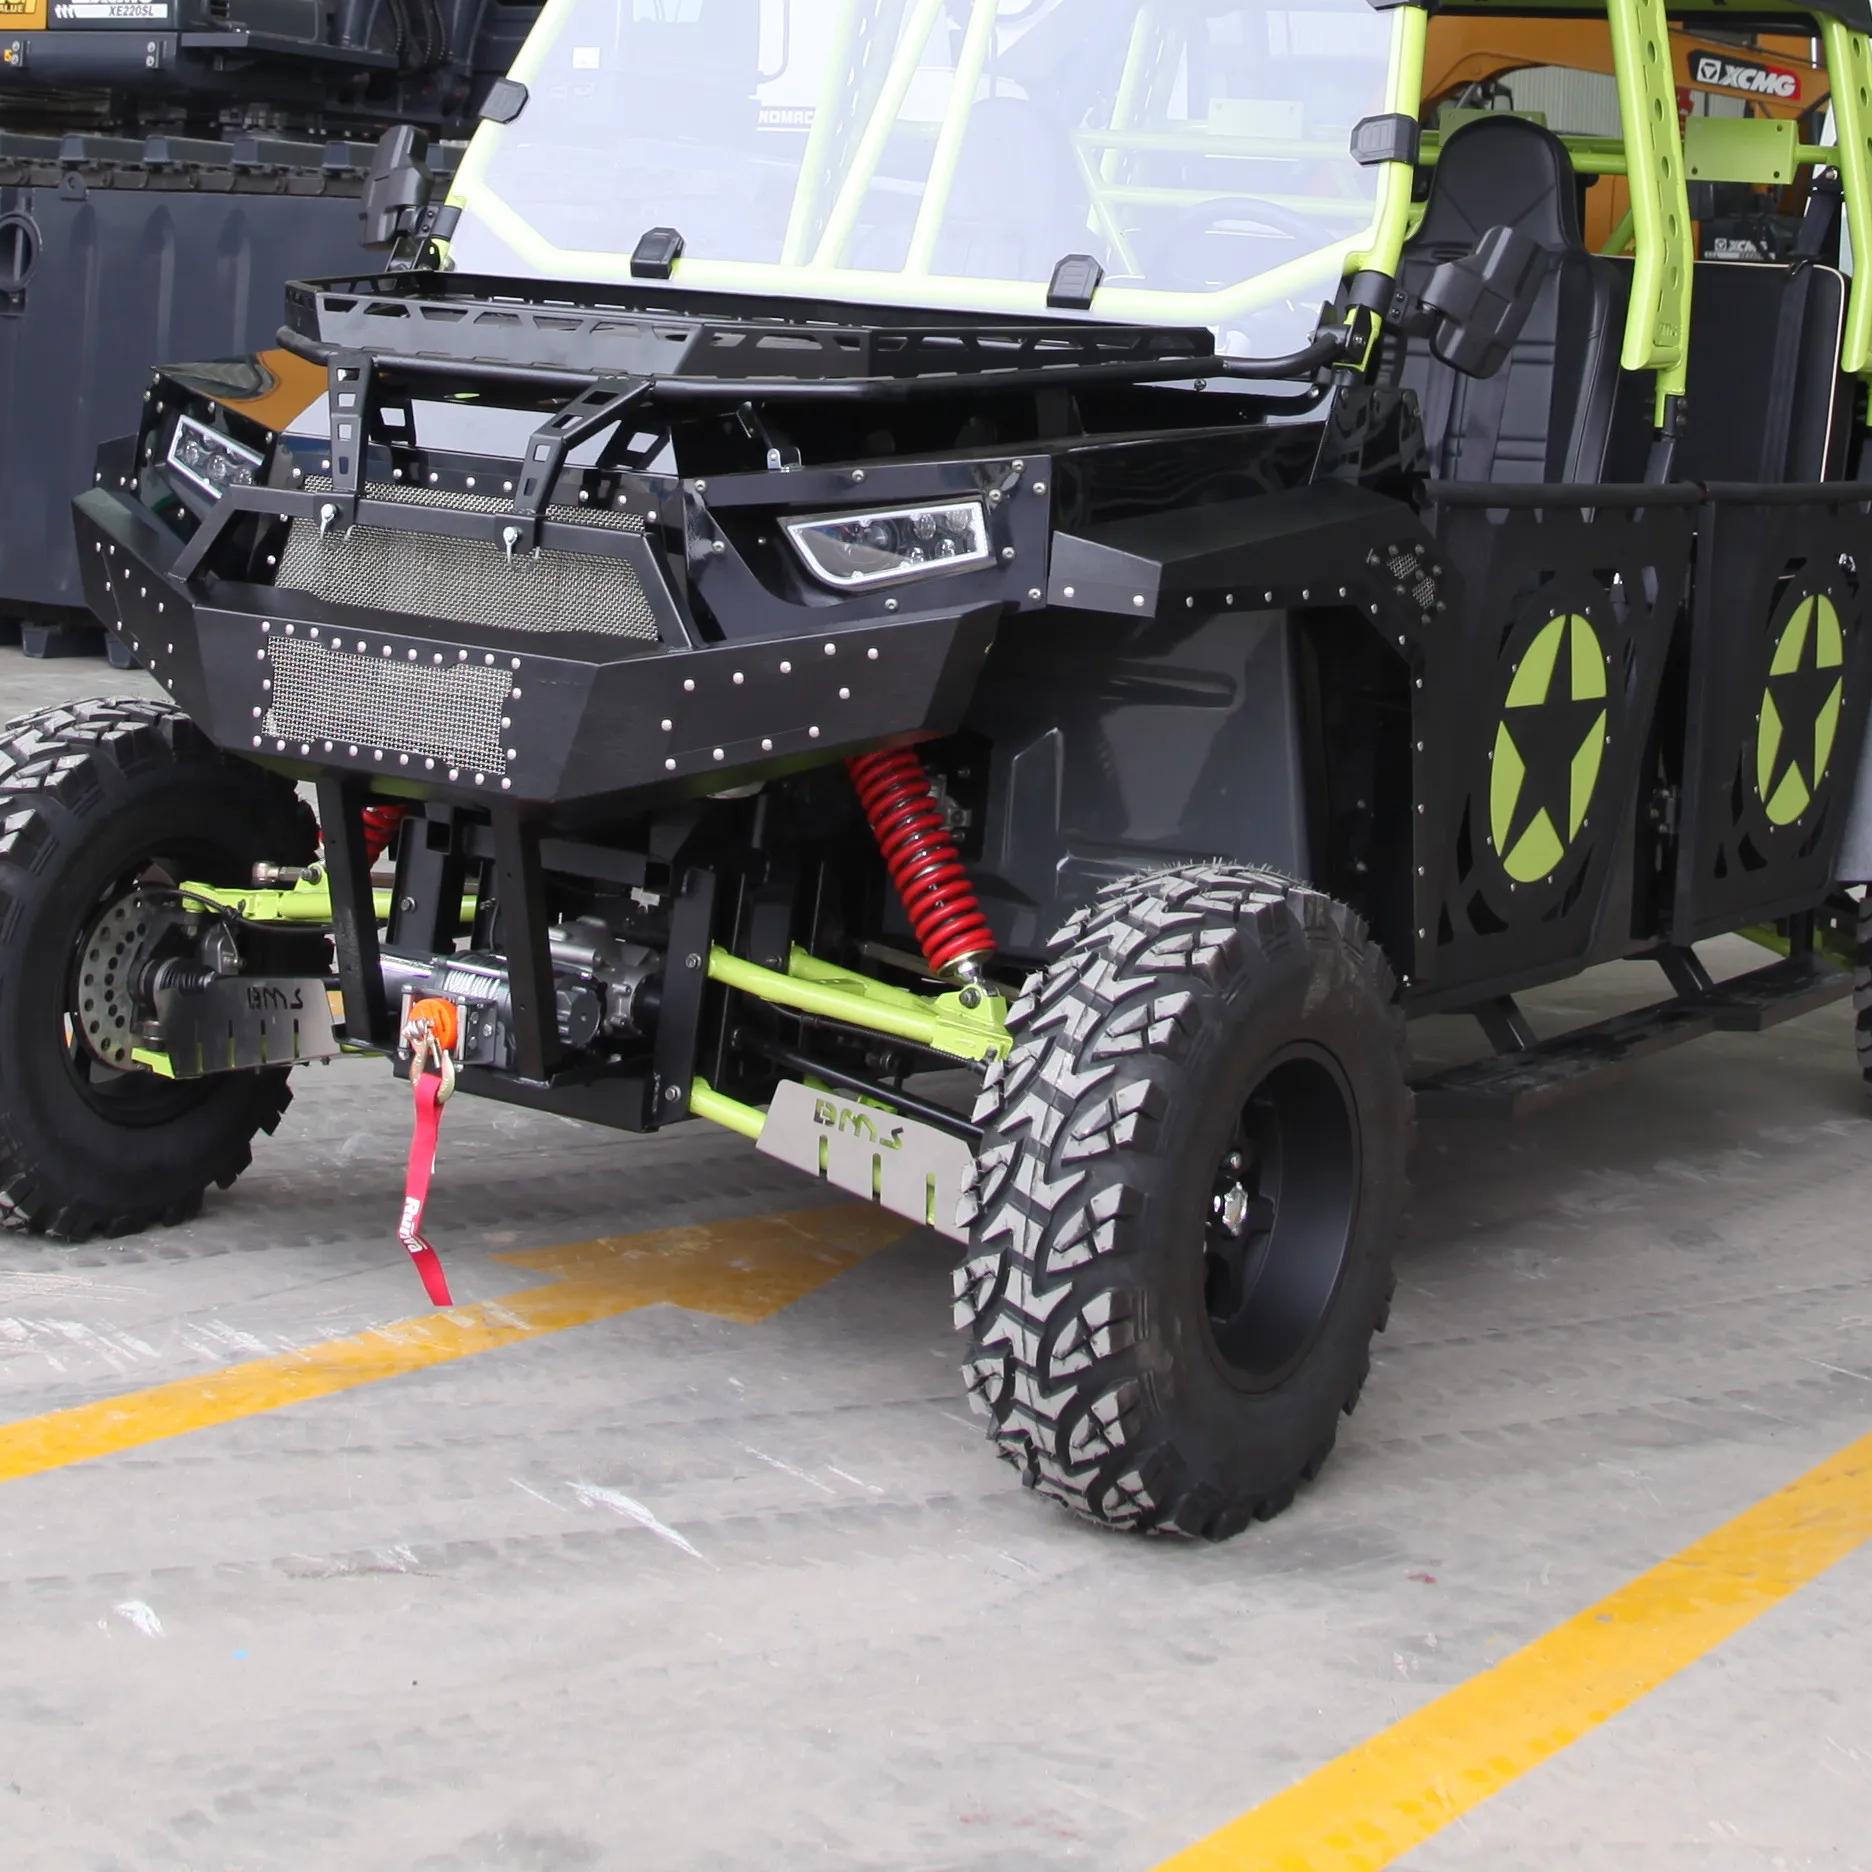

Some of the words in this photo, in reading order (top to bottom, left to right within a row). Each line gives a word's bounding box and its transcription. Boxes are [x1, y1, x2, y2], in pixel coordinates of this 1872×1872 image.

[109, 5, 154, 17] XE220SL
[1718, 64, 1796, 98] XCMG
[1728, 239, 1768, 253] XCM
